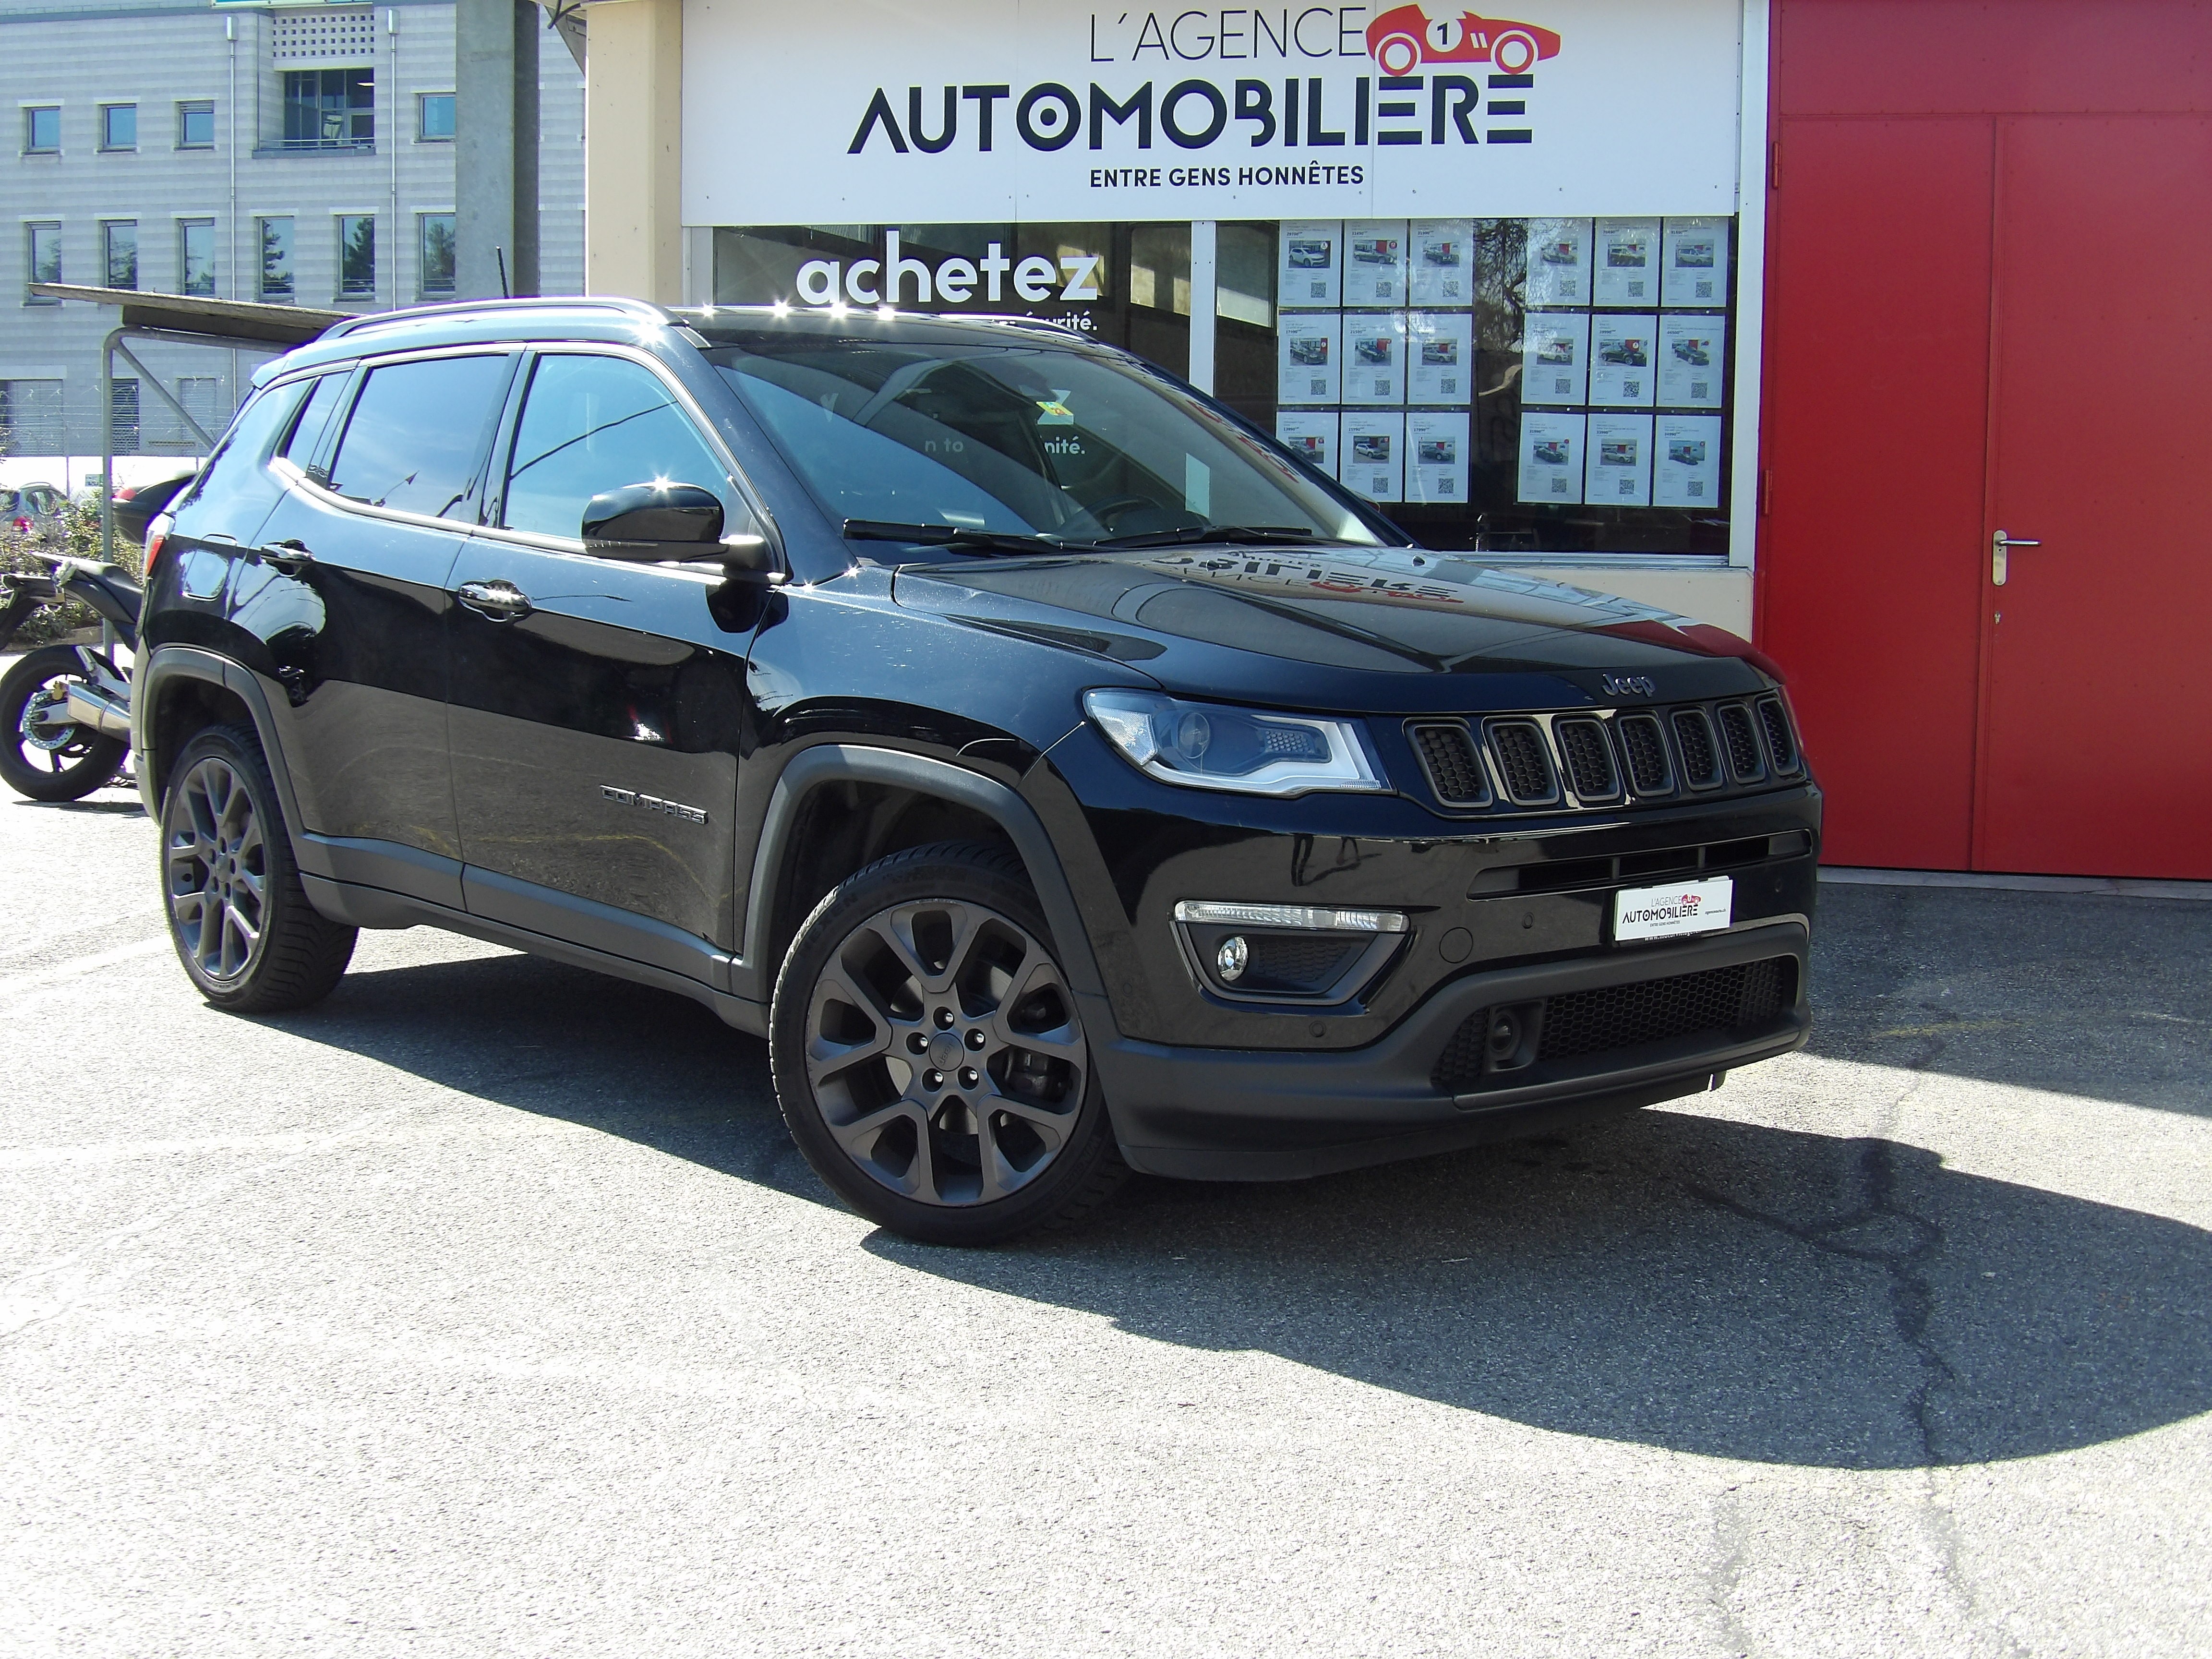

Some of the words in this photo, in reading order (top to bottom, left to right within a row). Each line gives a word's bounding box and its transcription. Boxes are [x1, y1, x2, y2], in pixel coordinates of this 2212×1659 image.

[1090, 7, 1366, 62] L'AGENCE
[847, 74, 1534, 154] AUTOMOBILIERE
[1090, 168, 1161, 188] ENTRE
[1169, 168, 1230, 186] GENS
[1238, 160, 1363, 186] HONNÊTES
[796, 230, 1099, 304] achetez
[1601, 673, 1655, 697] Jeep
[600, 784, 709, 825] COMPASS
[1622, 904, 1699, 924] AUTOMOBILIERE
[1651, 895, 1682, 907] L'AGENCE
